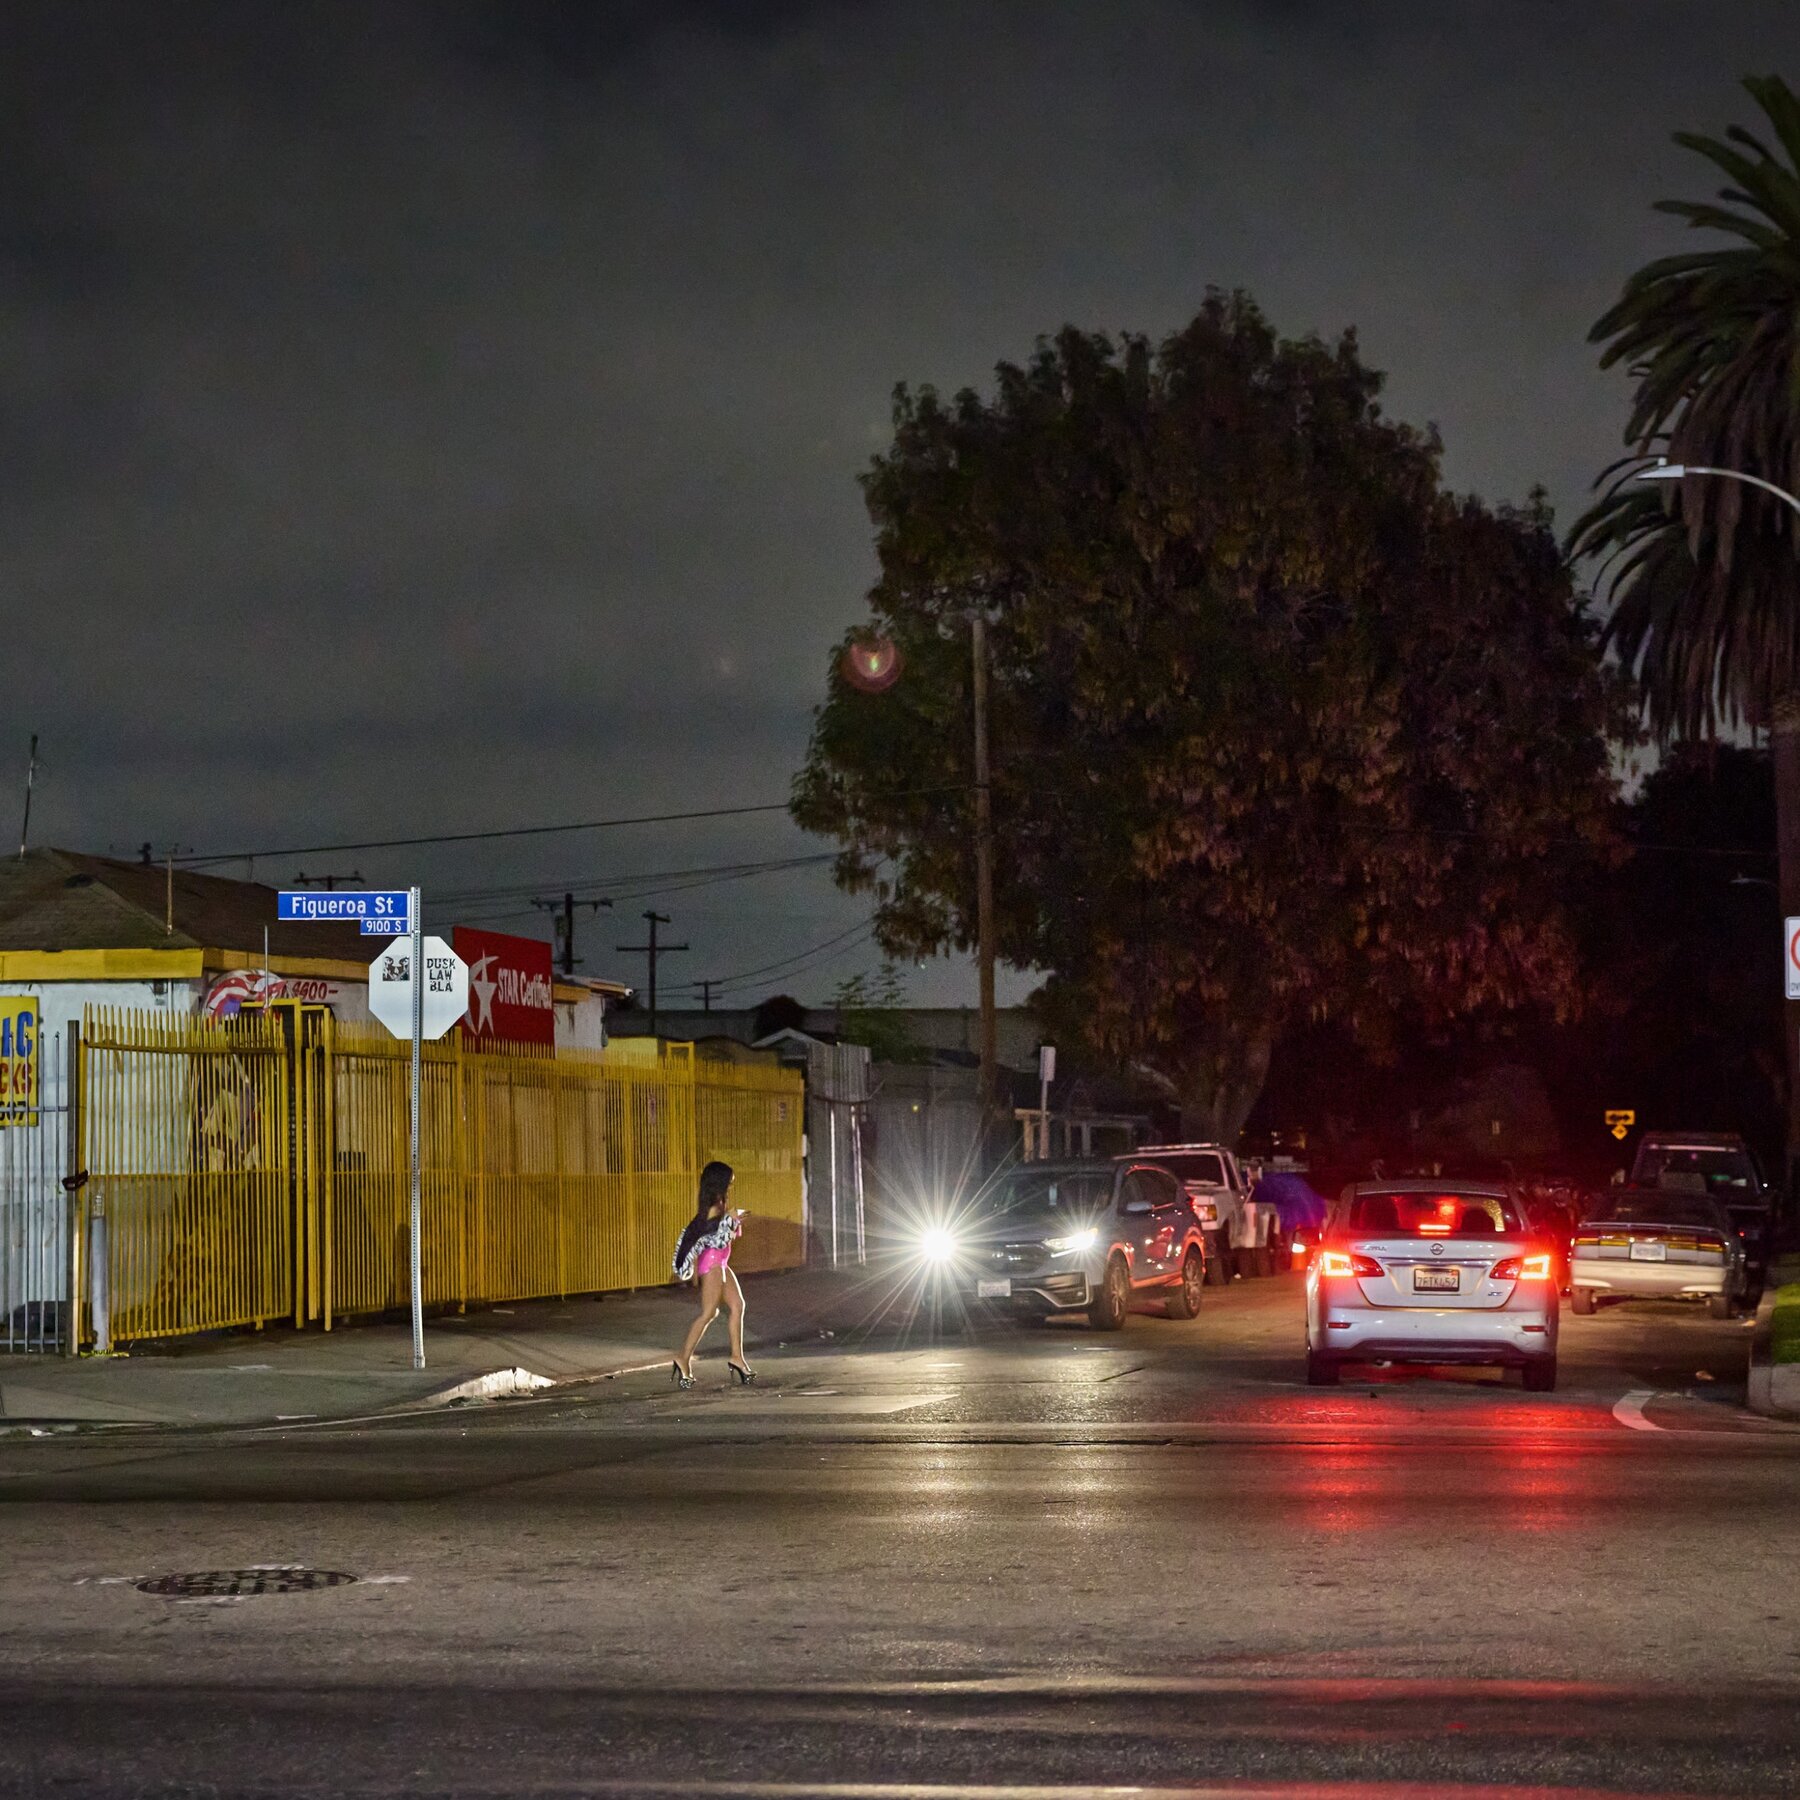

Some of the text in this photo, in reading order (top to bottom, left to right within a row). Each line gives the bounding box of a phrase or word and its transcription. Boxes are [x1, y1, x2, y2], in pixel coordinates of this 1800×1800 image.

[292, 896, 394, 918] Figueroa St
[366, 920, 402, 932] 9100 S
[426, 957, 456, 969] DUSK
[498, 967, 553, 1011] STAR Certified
